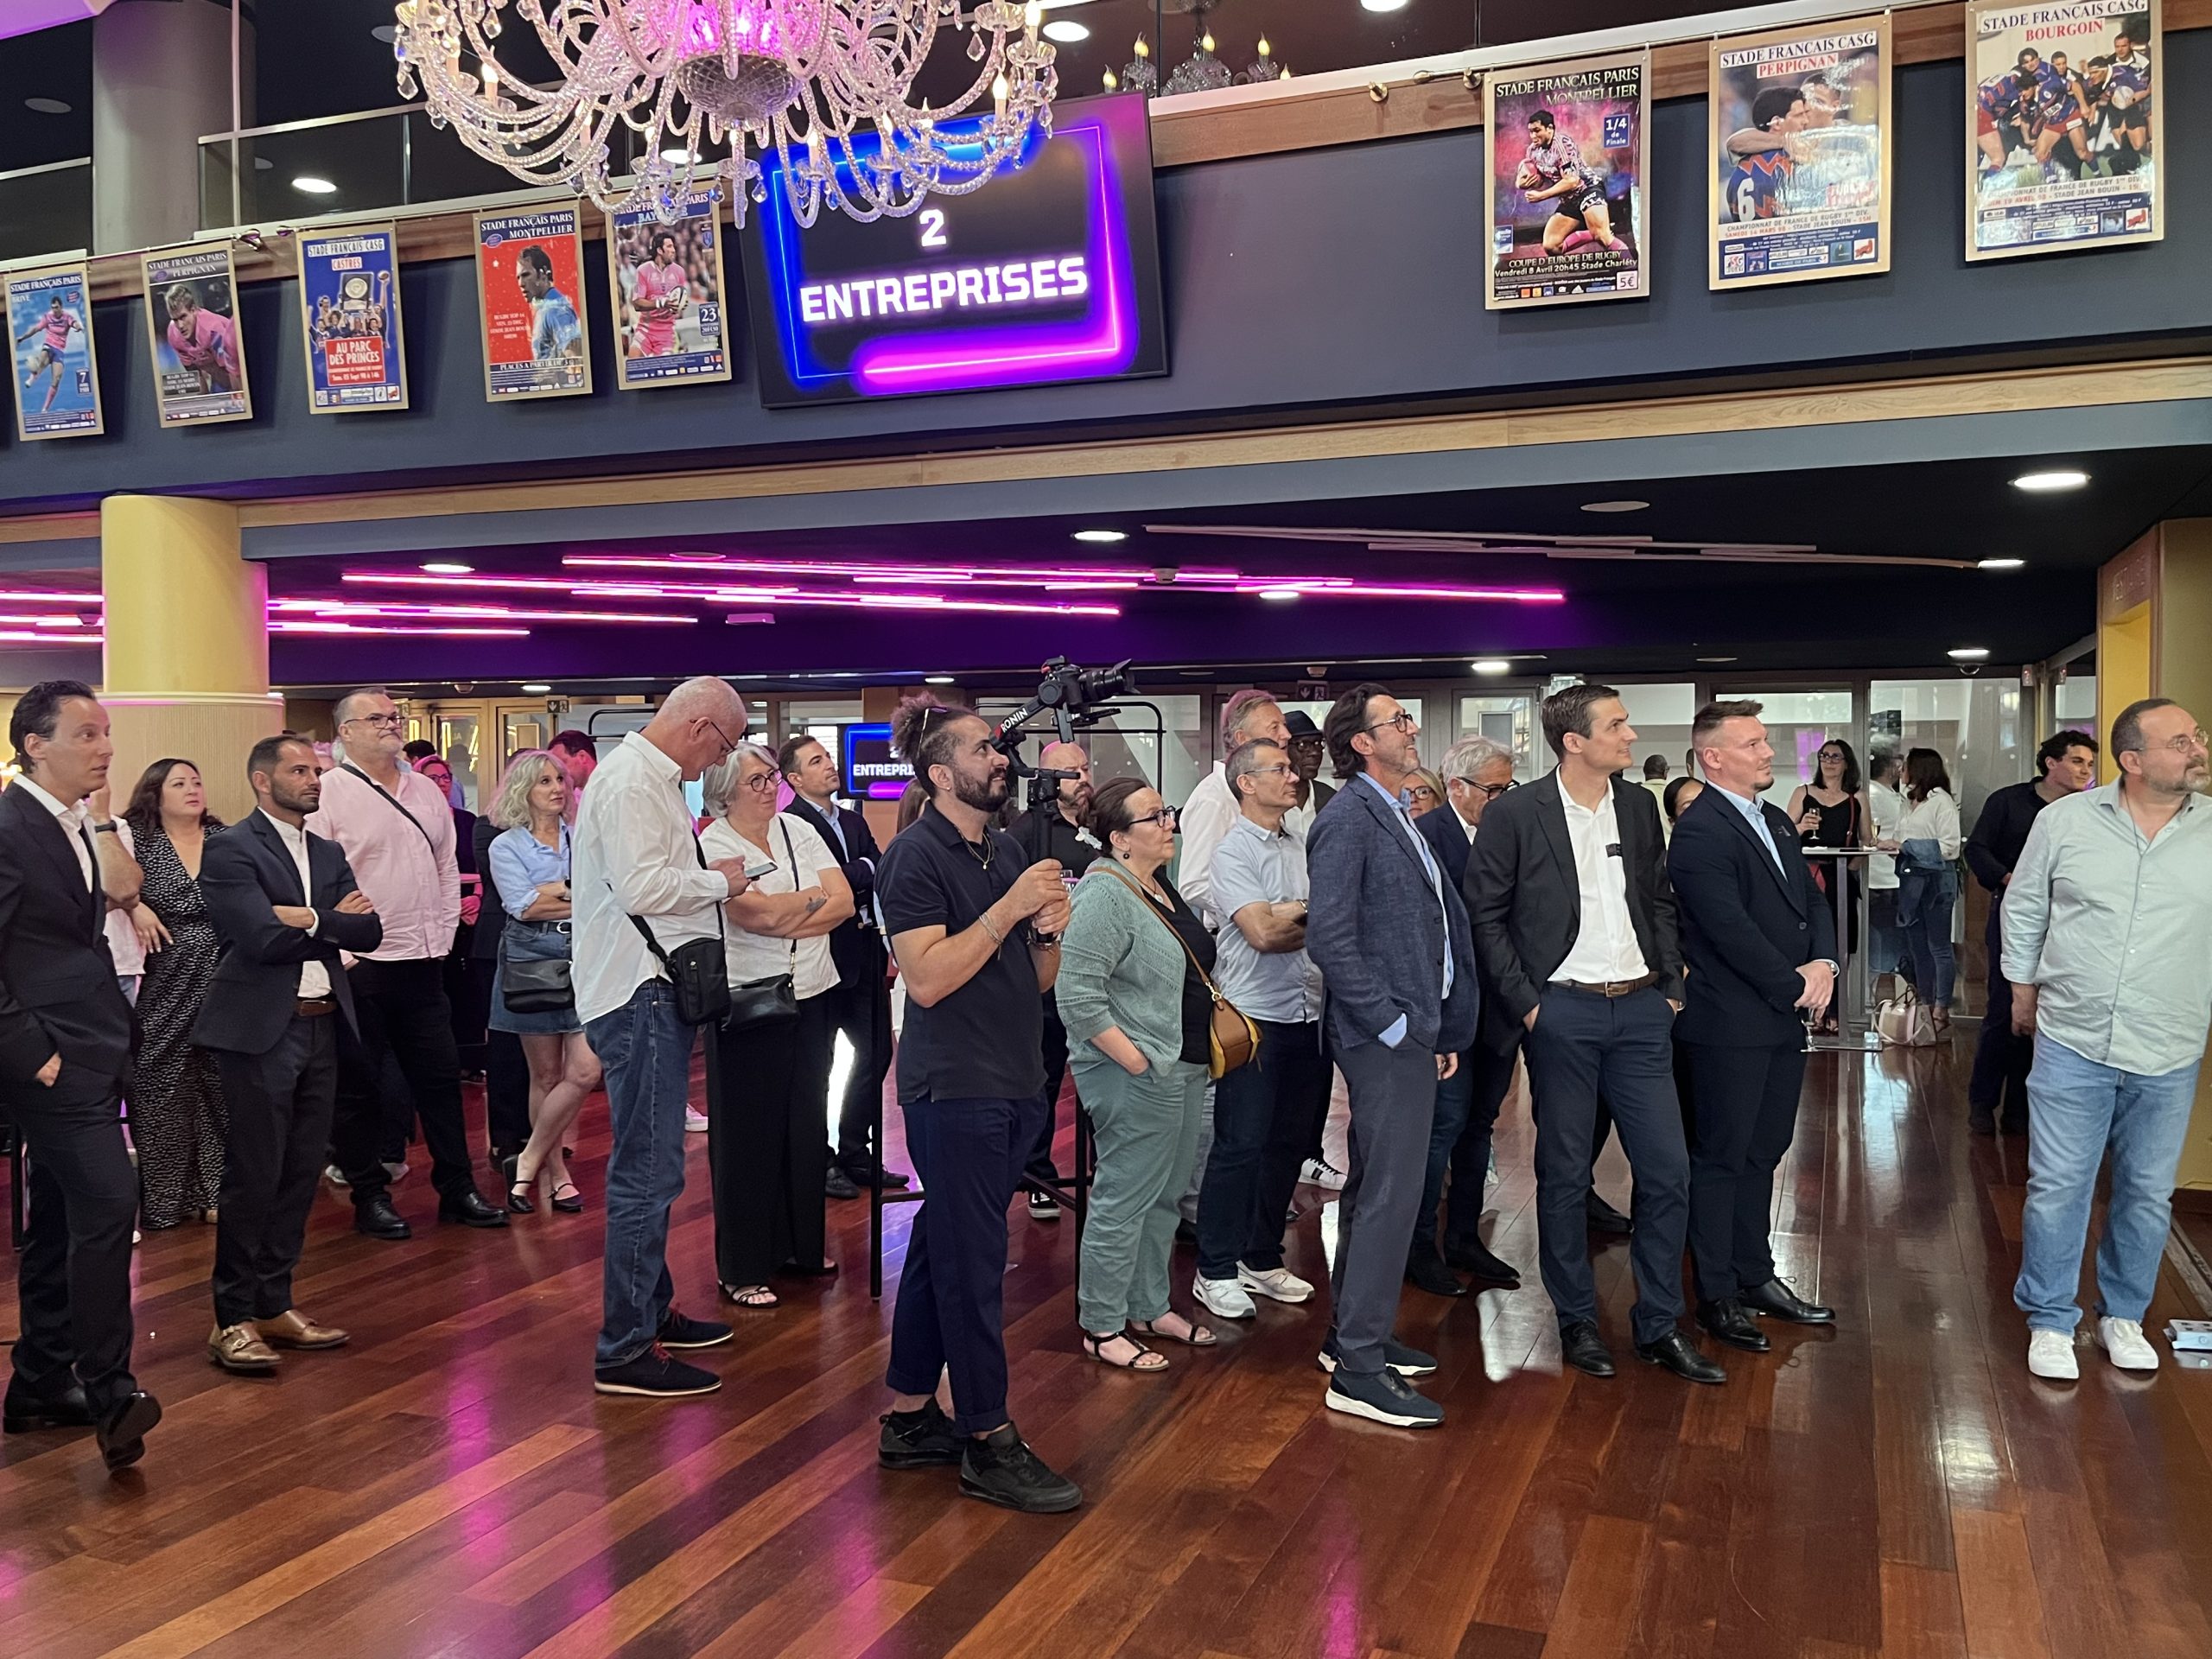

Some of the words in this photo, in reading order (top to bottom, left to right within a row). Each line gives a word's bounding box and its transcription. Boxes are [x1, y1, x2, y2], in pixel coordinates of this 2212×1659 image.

[1983, 14, 2029, 32] STADE
[2107, 0, 2145, 13] CASG
[2025, 20, 2103, 41] BOURGOIN
[1722, 49, 1765, 67] STADE
[1838, 33, 1873, 49] CASG
[1758, 54, 1837, 77] PERPIGNAN
[1496, 80, 1535, 98] STADE
[1604, 67, 1639, 83] PARIS
[1545, 84, 1638, 105] MONTPELLIER
[1605, 118, 1627, 131] 1/4
[1738, 178, 1756, 222] 6
[2054, 190, 2075, 199] STADE
[2077, 188, 2095, 196] JEAN
[481, 221, 508, 232] STADE
[508, 217, 549, 229] FRANÇAIS
[550, 213, 574, 224] PARIS
[918, 208, 947, 247] 2
[1727, 220, 1772, 232] CHAMPIONNAT
[1784, 217, 1808, 226] FRANCE
[509, 224, 574, 239] MONTPELLIER
[309, 245, 328, 256] STADE
[365, 239, 384, 251] CASG
[149, 262, 170, 270] STADE
[207, 251, 228, 262] PARIS
[333, 258, 361, 269] CASTRES
[1495, 267, 1528, 277] Vendredi
[1535, 265, 1553, 274] Avril
[1554, 263, 1580, 272] 20h45
[1581, 261, 1604, 270] Stade
[1605, 258, 1637, 268] Charléty
[1509, 257, 1537, 268] COUPE
[1582, 252, 1593, 262] DE
[1594, 251, 1622, 260] RUGBY
[173, 264, 217, 277] PERPIGNAN
[10, 283, 30, 293] STADE
[63, 275, 81, 286] PARIS
[800, 257, 1088, 322] ENTREPRISES
[1620, 276, 1635, 288] 5€
[11, 295, 30, 303] BRIVE
[701, 308, 717, 322] 23
[336, 342, 347, 353] AU
[349, 340, 372, 353] PARC
[329, 354, 345, 365] DES
[346, 351, 380, 365] PRINCES
[499, 362, 524, 371] PLACES
[79, 372, 86, 383] 7
[1001, 708, 1028, 733] RONIN
[853, 764, 915, 777] ENTREPRI
